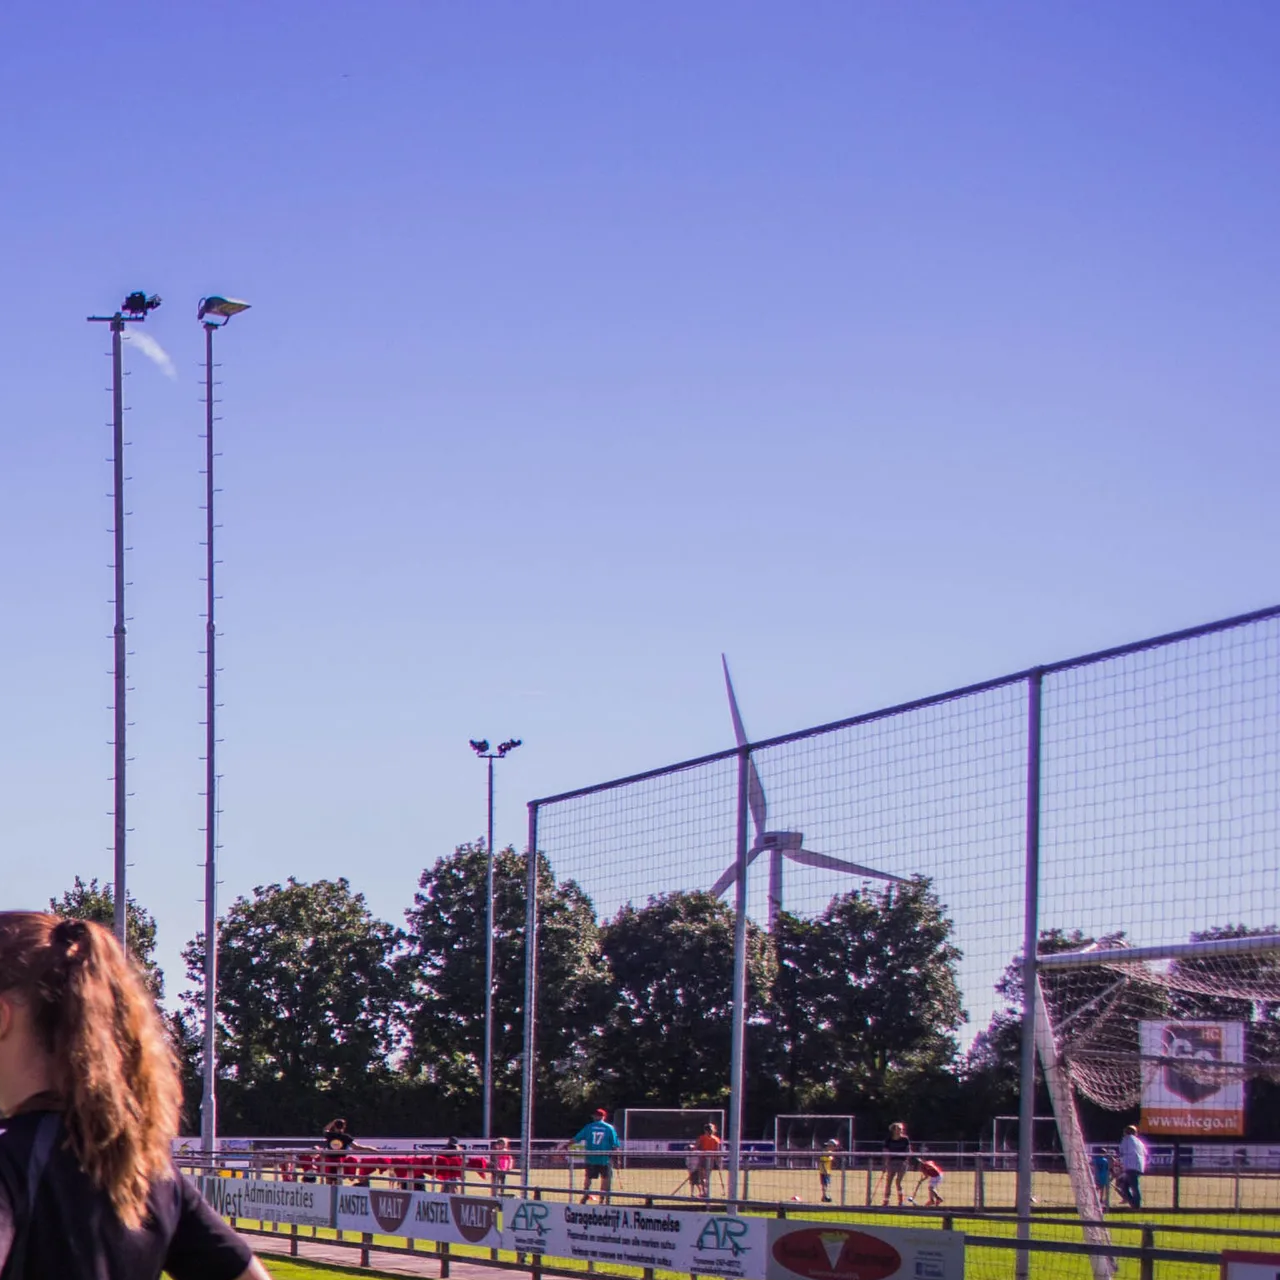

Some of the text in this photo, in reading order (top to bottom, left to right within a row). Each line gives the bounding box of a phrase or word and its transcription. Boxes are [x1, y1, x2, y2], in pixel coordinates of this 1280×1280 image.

[1146, 1114, 1238, 1131] www.hcgo.nl
[592, 1131, 605, 1145] 17
[211, 1178, 243, 1218] West
[244, 1181, 315, 1209] Administraties
[338, 1193, 370, 1216] AMSTEL
[378, 1195, 404, 1220] MALT
[415, 1200, 450, 1224] AMSTEL
[460, 1203, 489, 1228] MALT
[564, 1206, 620, 1233] Garagebedrijf
